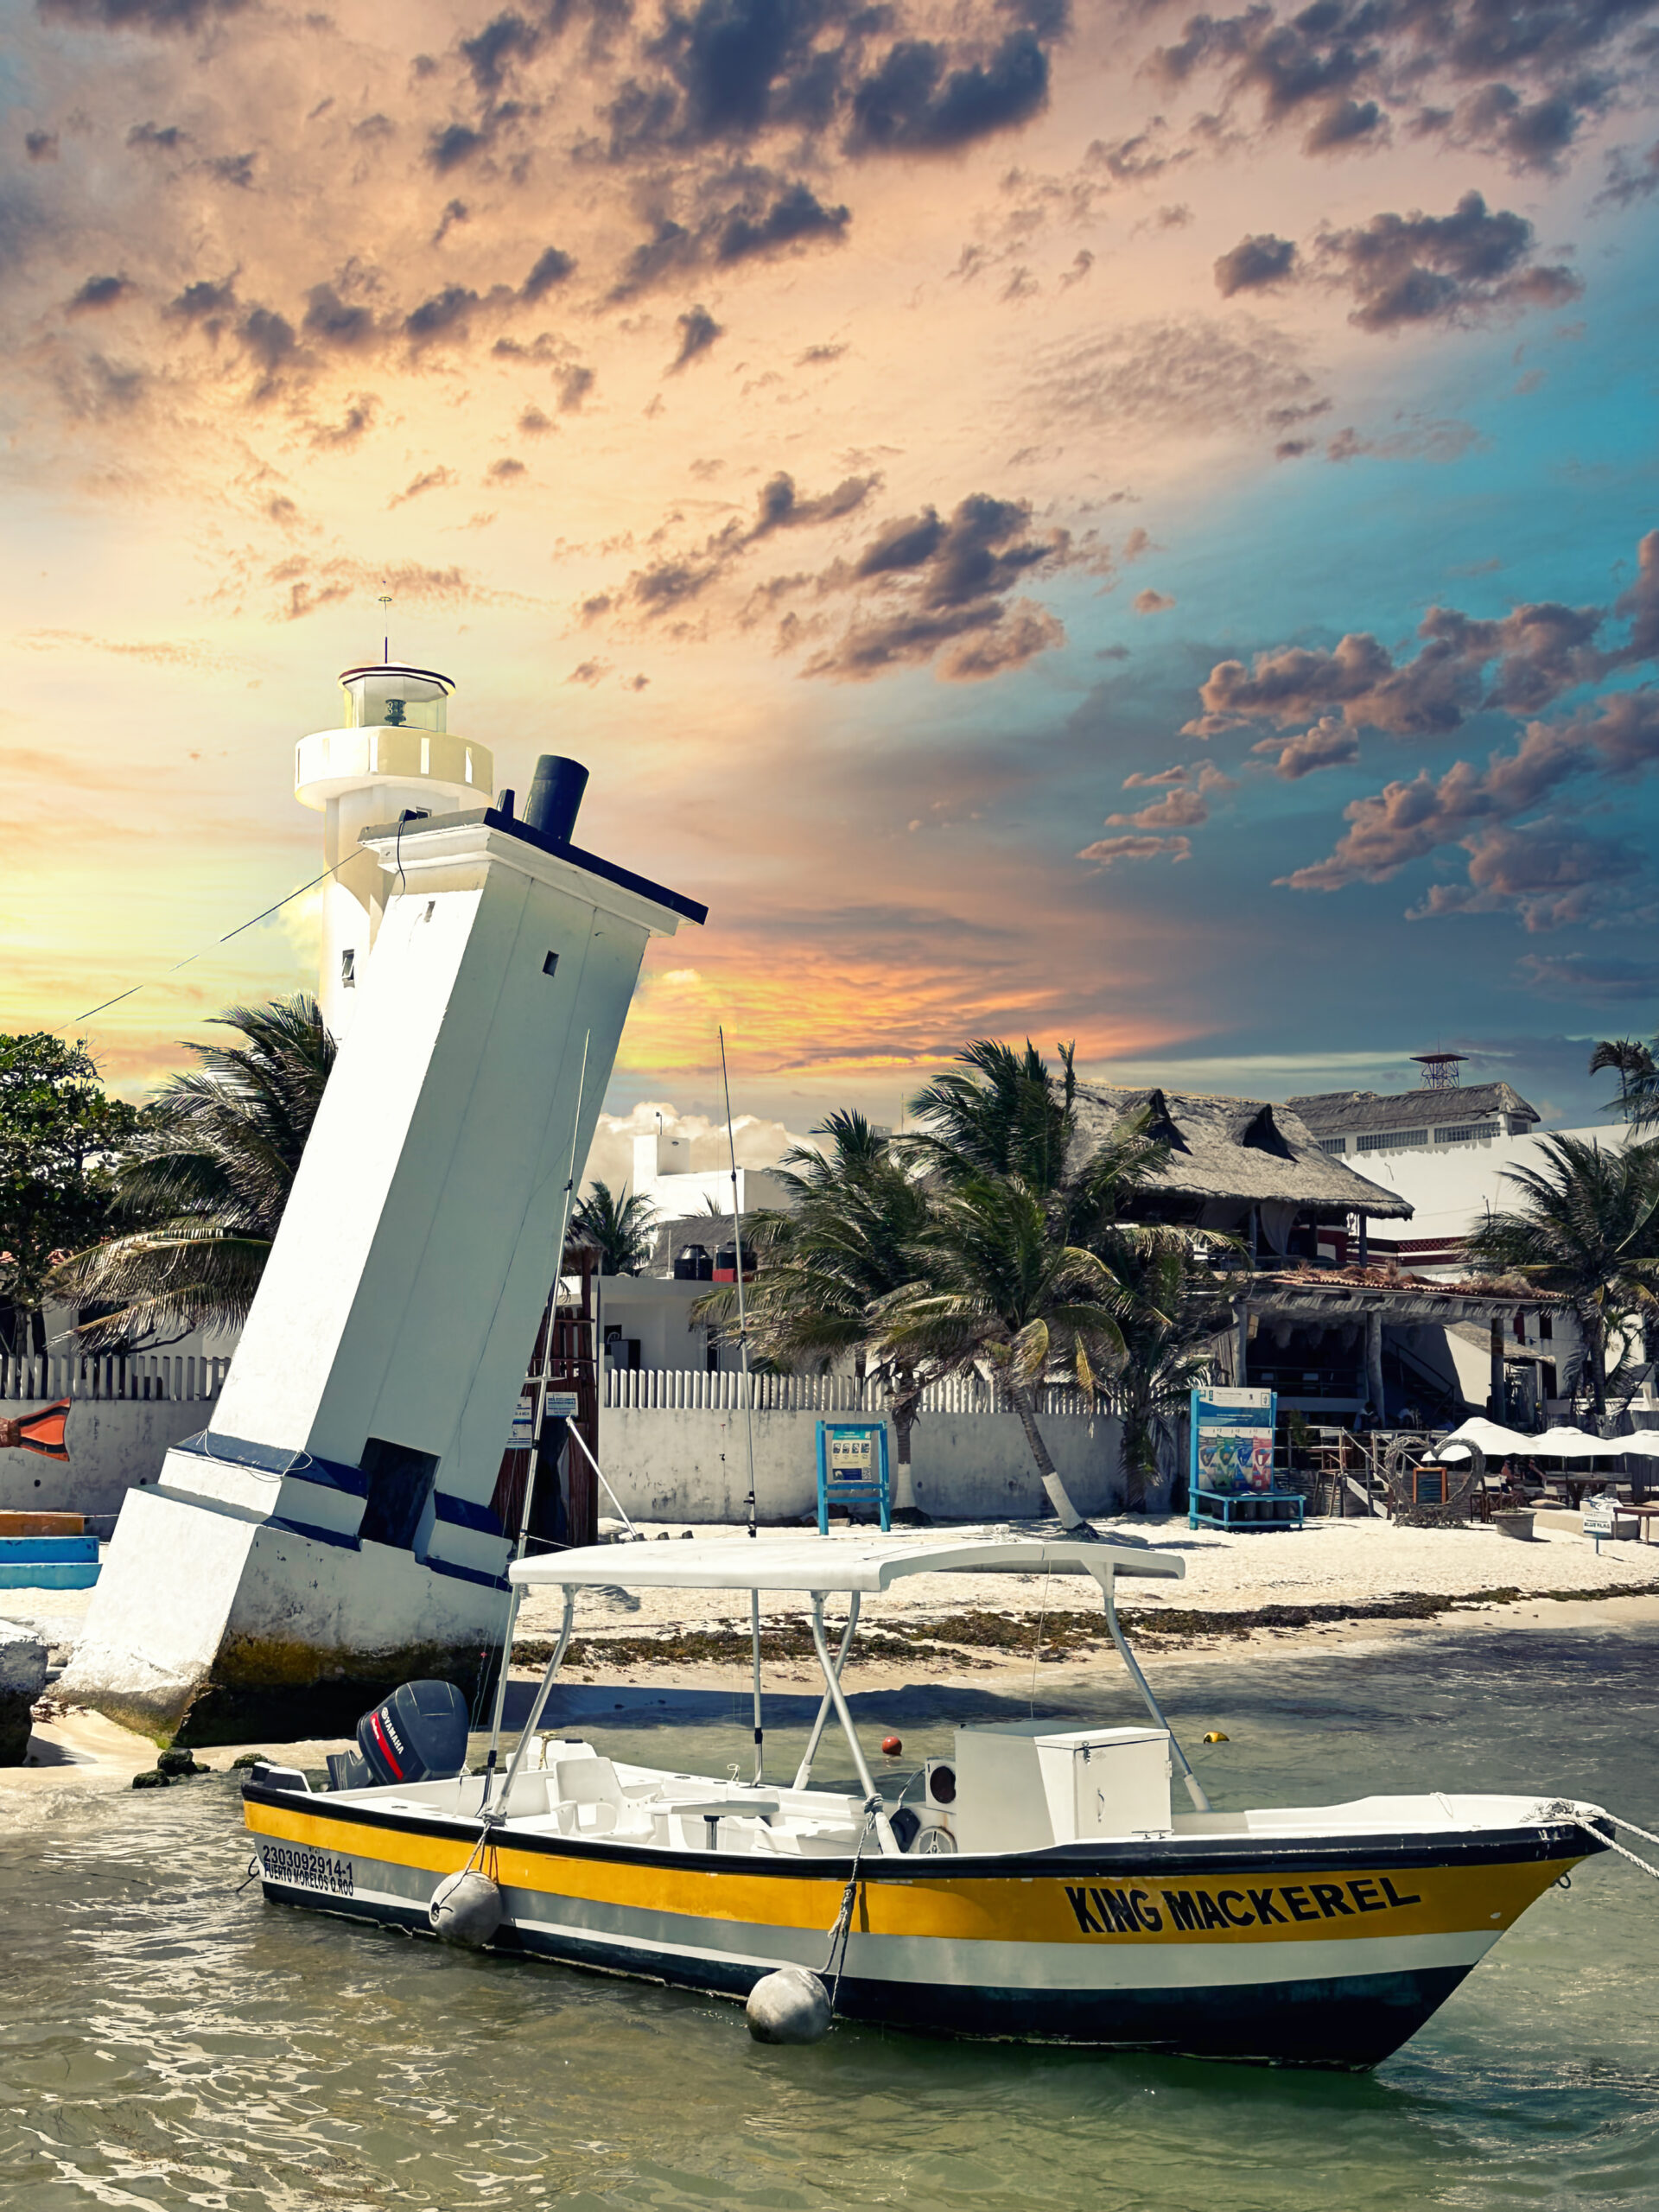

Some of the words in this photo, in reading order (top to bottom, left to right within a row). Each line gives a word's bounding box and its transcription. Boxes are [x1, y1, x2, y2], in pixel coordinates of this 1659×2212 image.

[384, 1716, 404, 1755] YAMAHA
[263, 1845, 353, 1880] 2303092914-1
[264, 1862, 293, 1884] PUERTO
[293, 1868, 329, 1891] MORELOS
[1065, 1886, 1164, 1934] KING
[1162, 1877, 1422, 1931] MACKEREL
